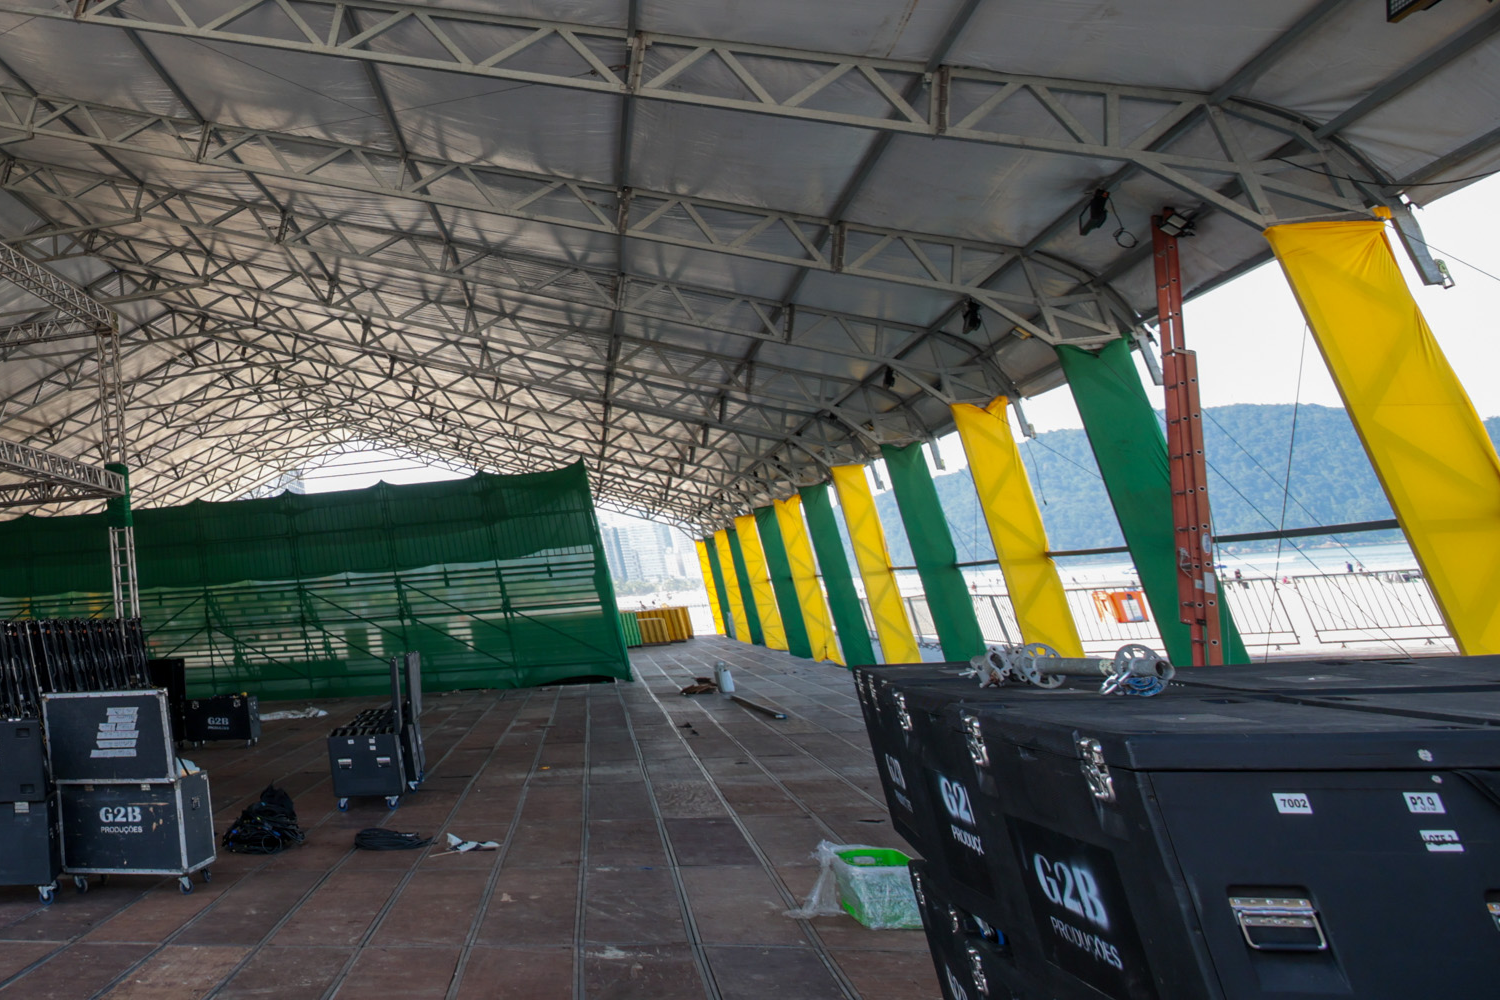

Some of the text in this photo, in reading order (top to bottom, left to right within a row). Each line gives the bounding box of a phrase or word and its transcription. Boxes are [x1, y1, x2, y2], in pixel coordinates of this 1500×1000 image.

[207, 717, 229, 725] G2B
[940, 774, 976, 827] G2
[1280, 798, 1308, 809] 7002
[1409, 796, 1436, 811] P3.9
[99, 806, 142, 822] G2B
[100, 826, 143, 834] PRODUÇÕES
[1033, 853, 1110, 930] G2B
[1050, 915, 1123, 971] PRODUÇÕES
